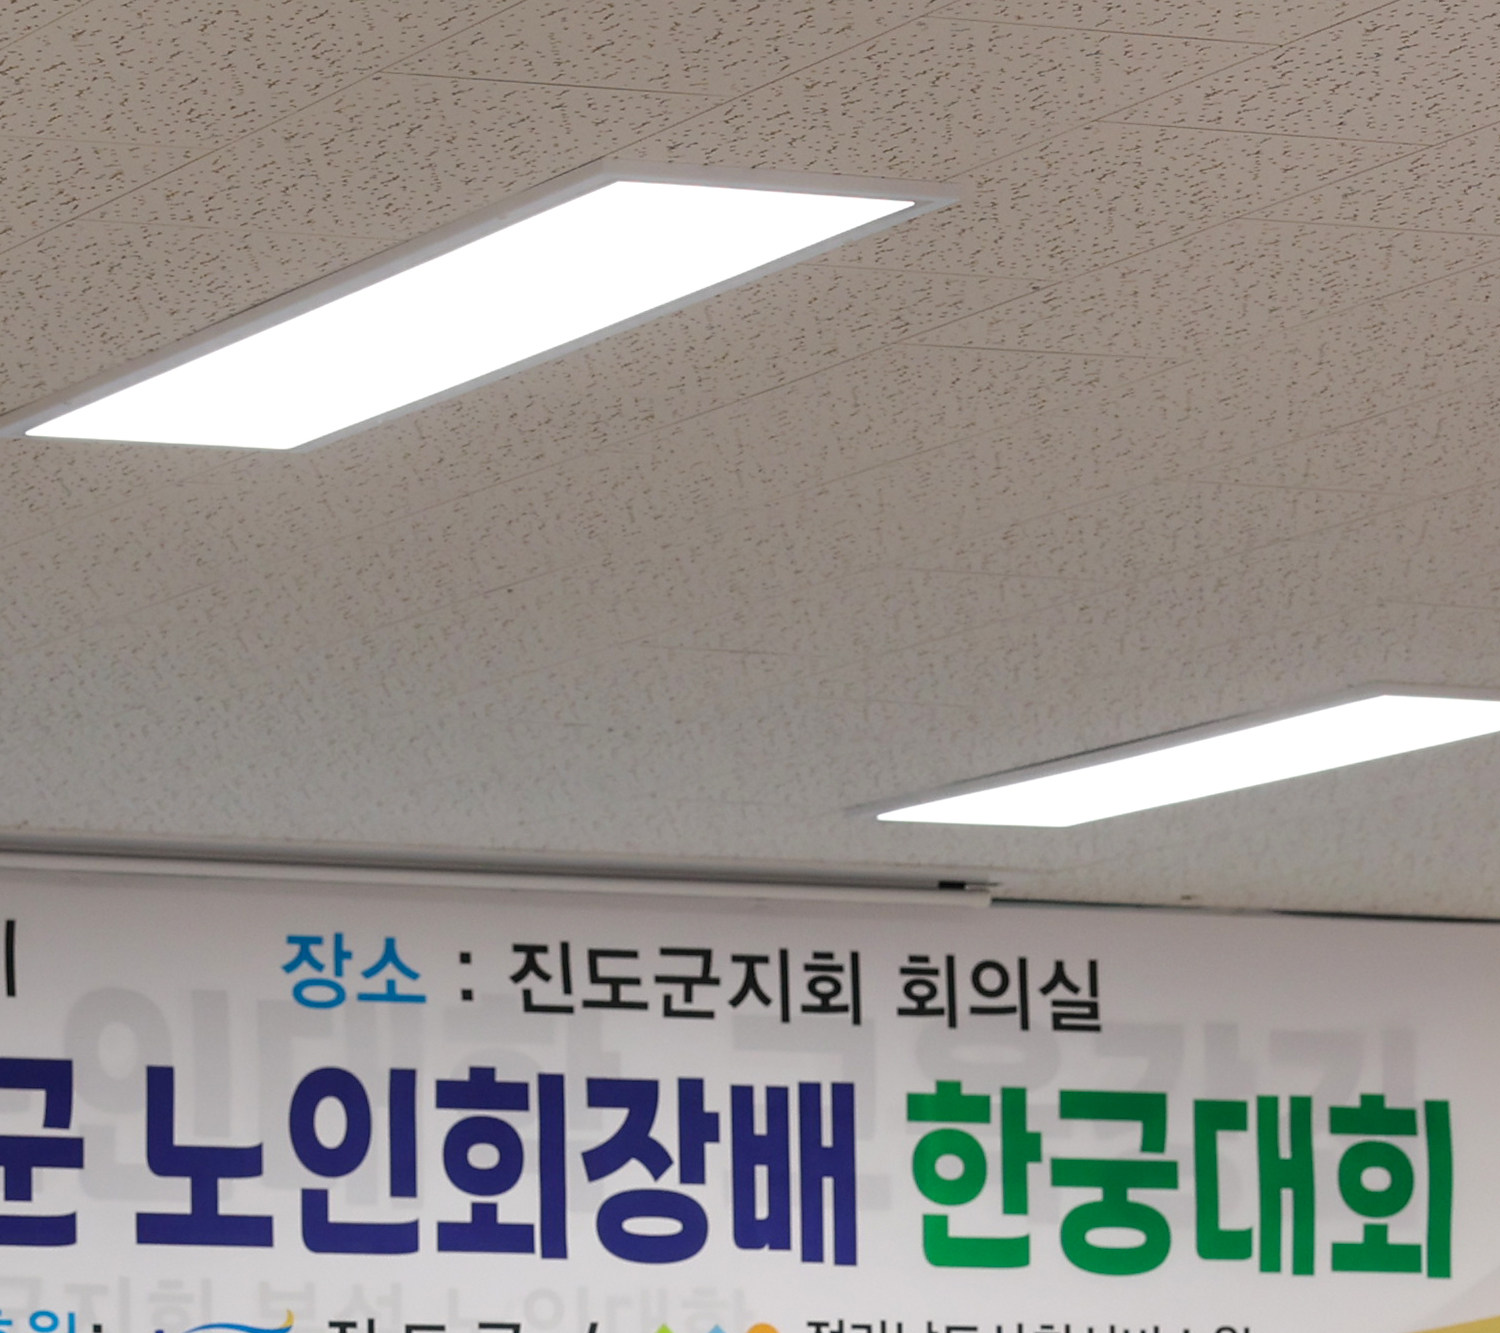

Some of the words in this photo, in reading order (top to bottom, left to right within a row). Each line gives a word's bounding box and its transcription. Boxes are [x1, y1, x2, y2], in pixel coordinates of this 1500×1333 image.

[283, 933, 426, 1008] 장소
[510, 942, 860, 1025] 진도군지회
[898, 955, 1101, 1032] 회의실
[136, 1066, 856, 1265] 노인회장배
[907, 1081, 1453, 1278] 한궁대회
